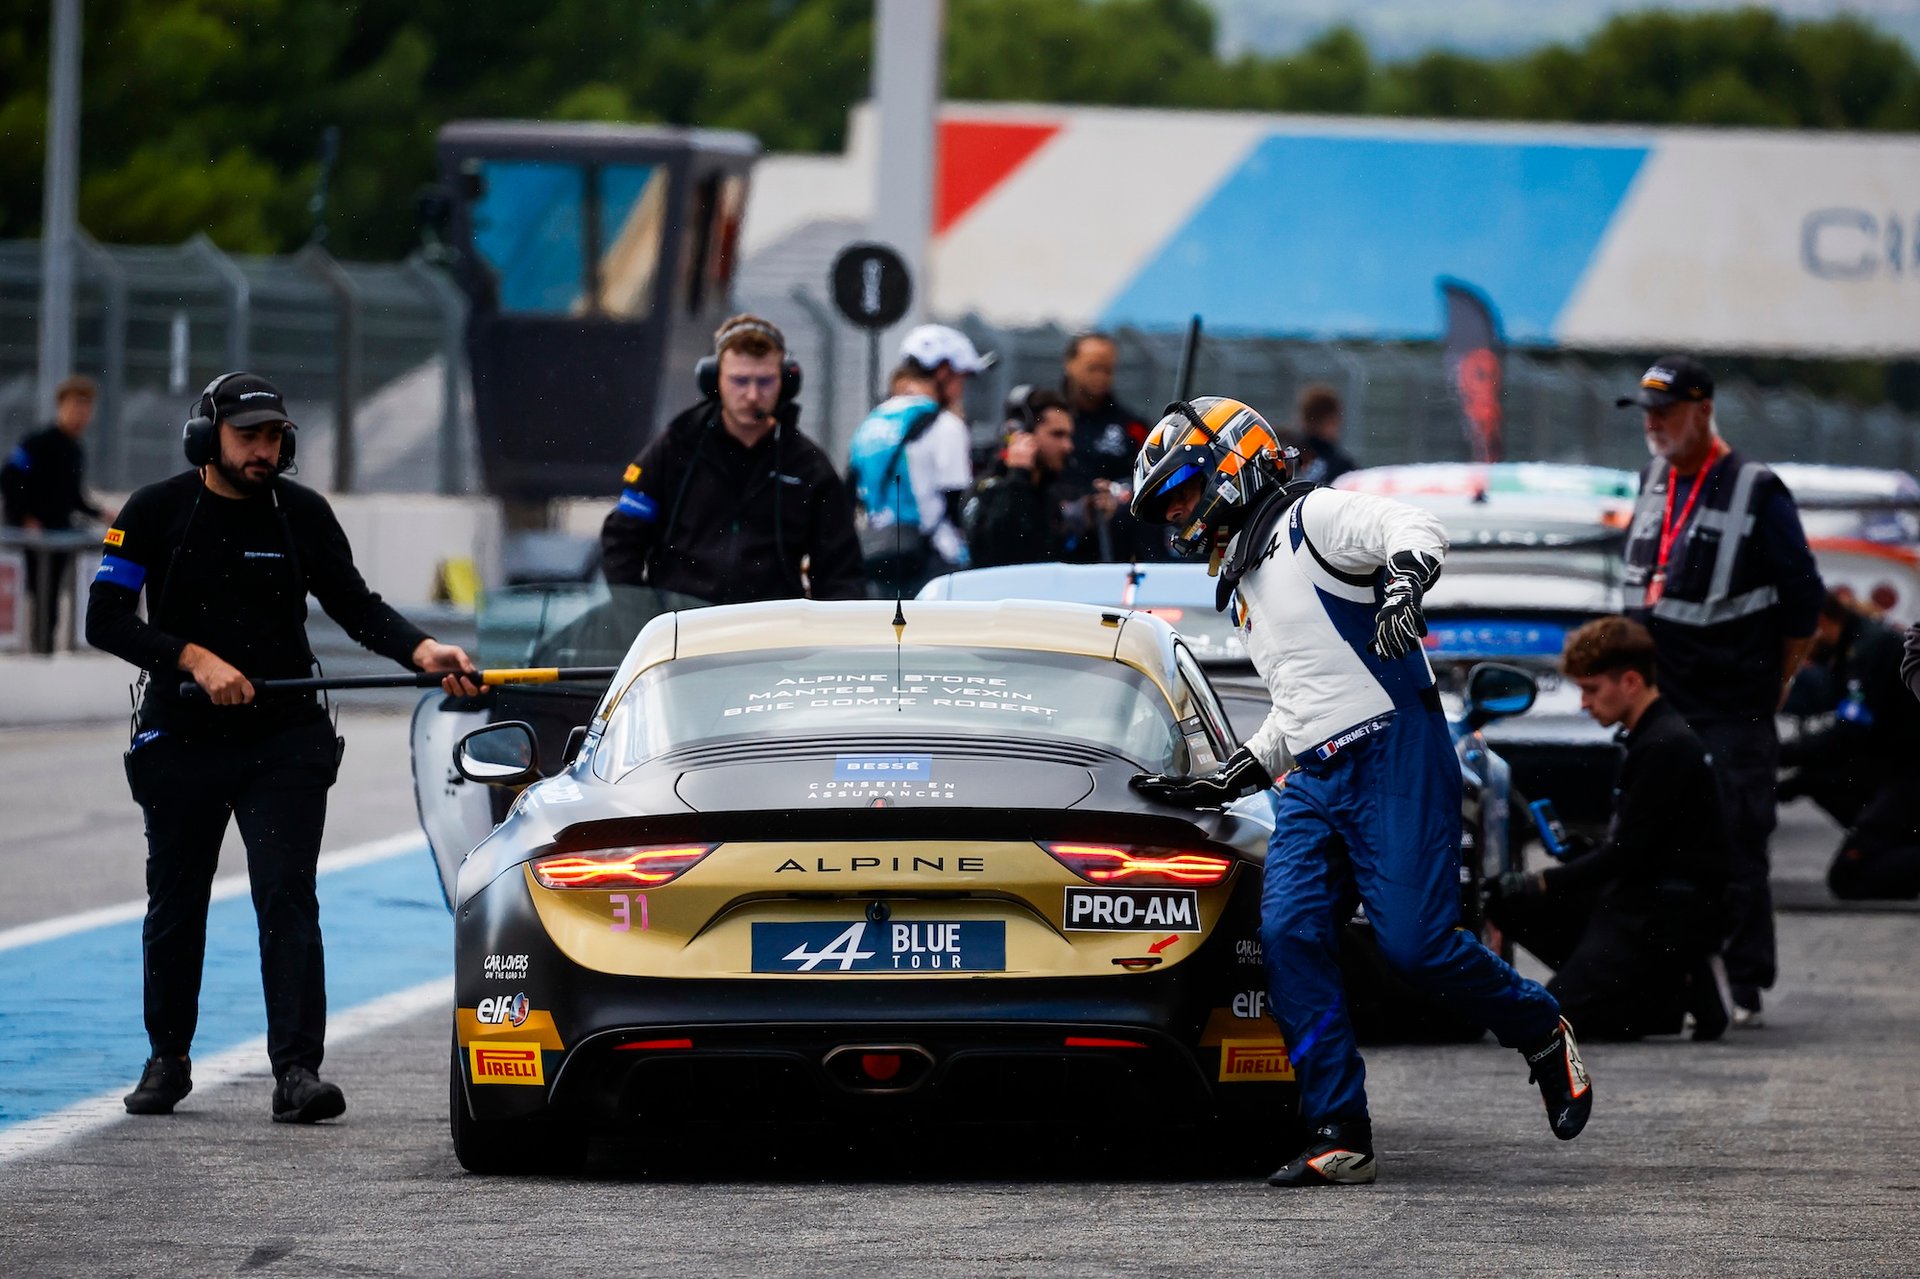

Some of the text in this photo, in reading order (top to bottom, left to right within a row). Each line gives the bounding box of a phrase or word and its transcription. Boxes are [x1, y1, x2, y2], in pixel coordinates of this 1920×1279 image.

[1800, 206, 1920, 281] CI
[749, 685, 1032, 701] MANTES LE VEXIN
[776, 674, 1007, 686] ALPINE STORE
[723, 698, 1058, 717] BRIE COMTE ROBERT
[1335, 721, 1382, 749] HERMET S.
[847, 761, 919, 770] BESSÉ
[808, 790, 955, 798] ASSURANCES
[809, 781, 912, 789] CONSEIL
[774, 857, 984, 872] ALPINE
[610, 894, 649, 931] 31
[1071, 895, 1192, 925] PRO-AM
[892, 923, 961, 953] BLUE
[892, 955, 961, 968] TOUR
[477, 996, 512, 1024] elf
[1232, 991, 1265, 1018] elf
[476, 1049, 537, 1077] PIRELLI
[1226, 1047, 1290, 1074] PIRELLI
